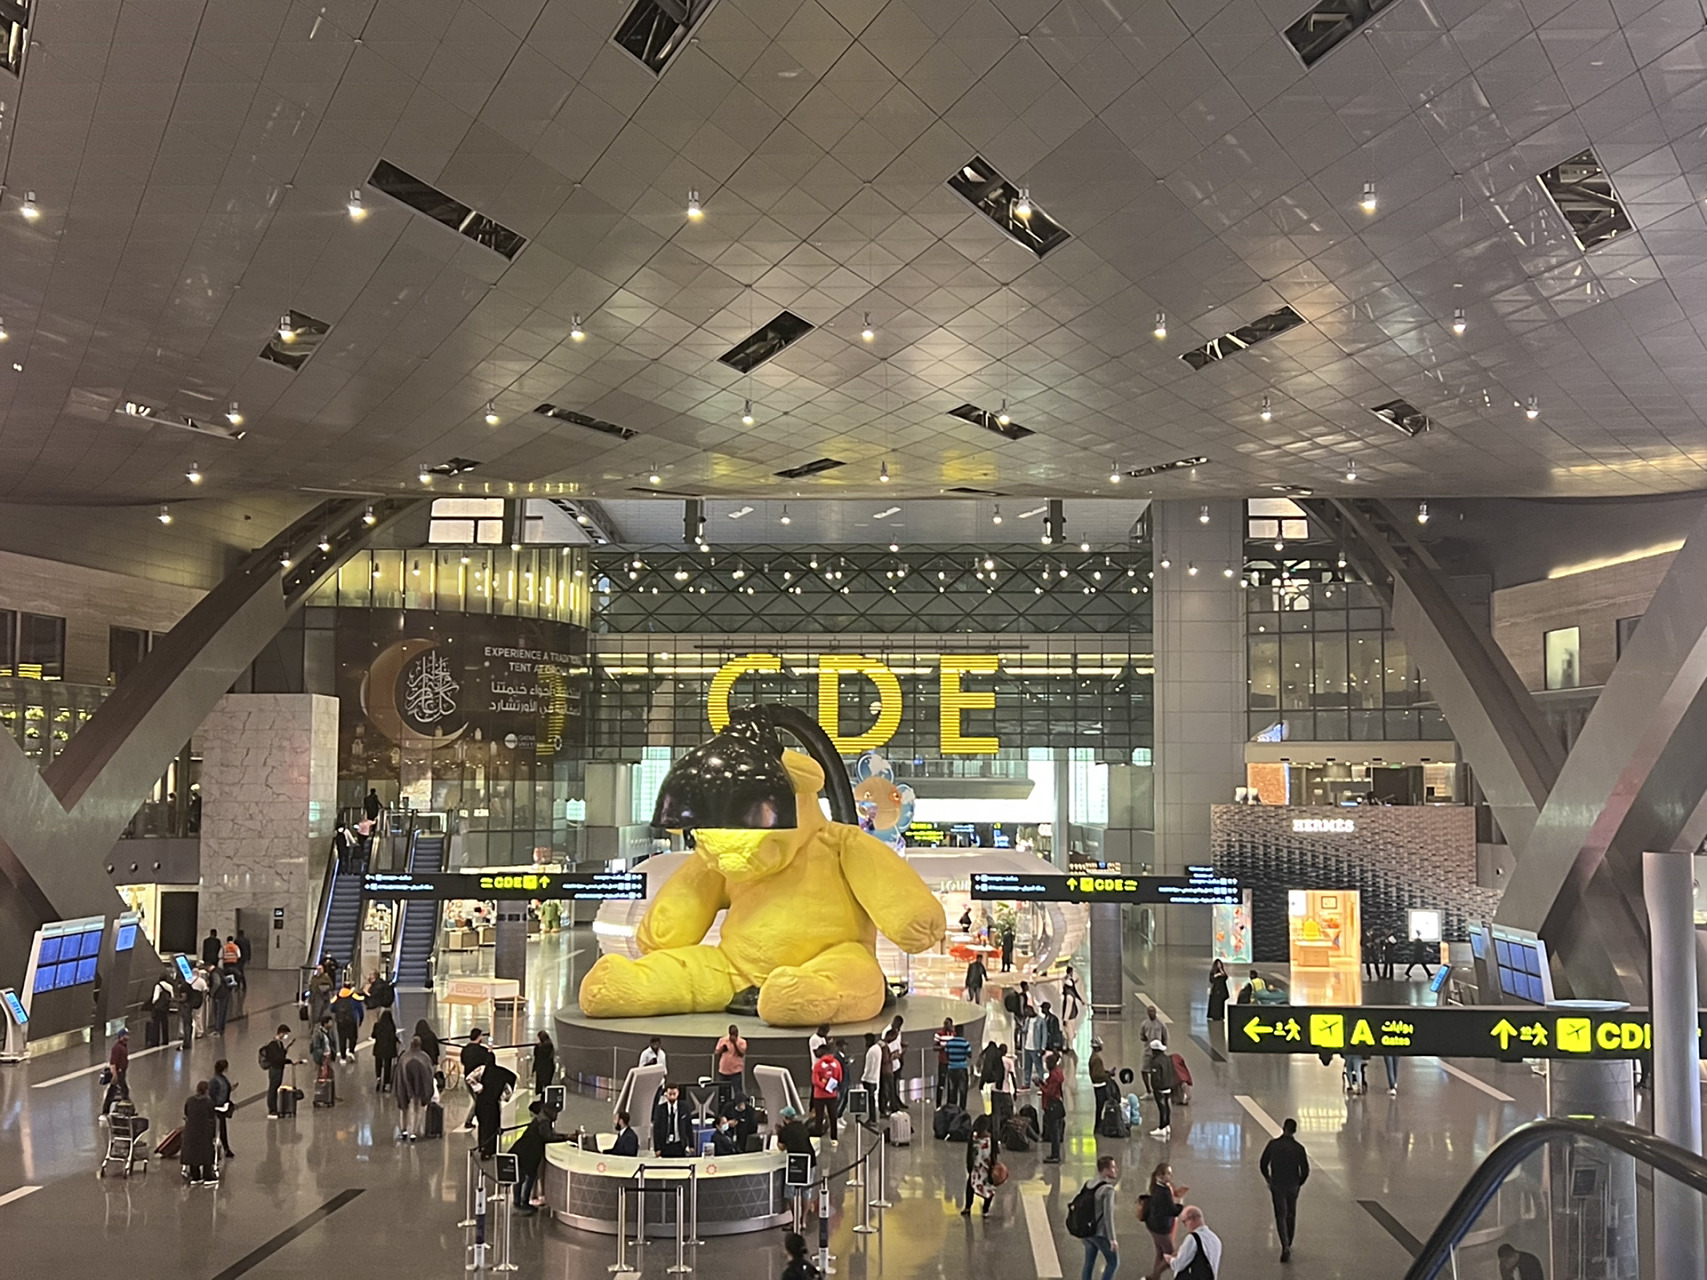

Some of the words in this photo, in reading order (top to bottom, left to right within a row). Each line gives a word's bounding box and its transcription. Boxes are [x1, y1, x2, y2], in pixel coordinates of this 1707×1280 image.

[485, 647, 541, 660] EXPERIENCE
[543, 652, 548, 661] A
[509, 662, 531, 672] TENT
[492, 682, 527, 697] خيمتنا
[489, 697, 537, 713] الأورتشارد
[494, 876, 522, 888] CDE
[1094, 879, 1124, 891] CDE
[1350, 1019, 1375, 1045] A
[1381, 1020, 1414, 1034] بوابات
[1381, 1034, 1411, 1046] Gates
